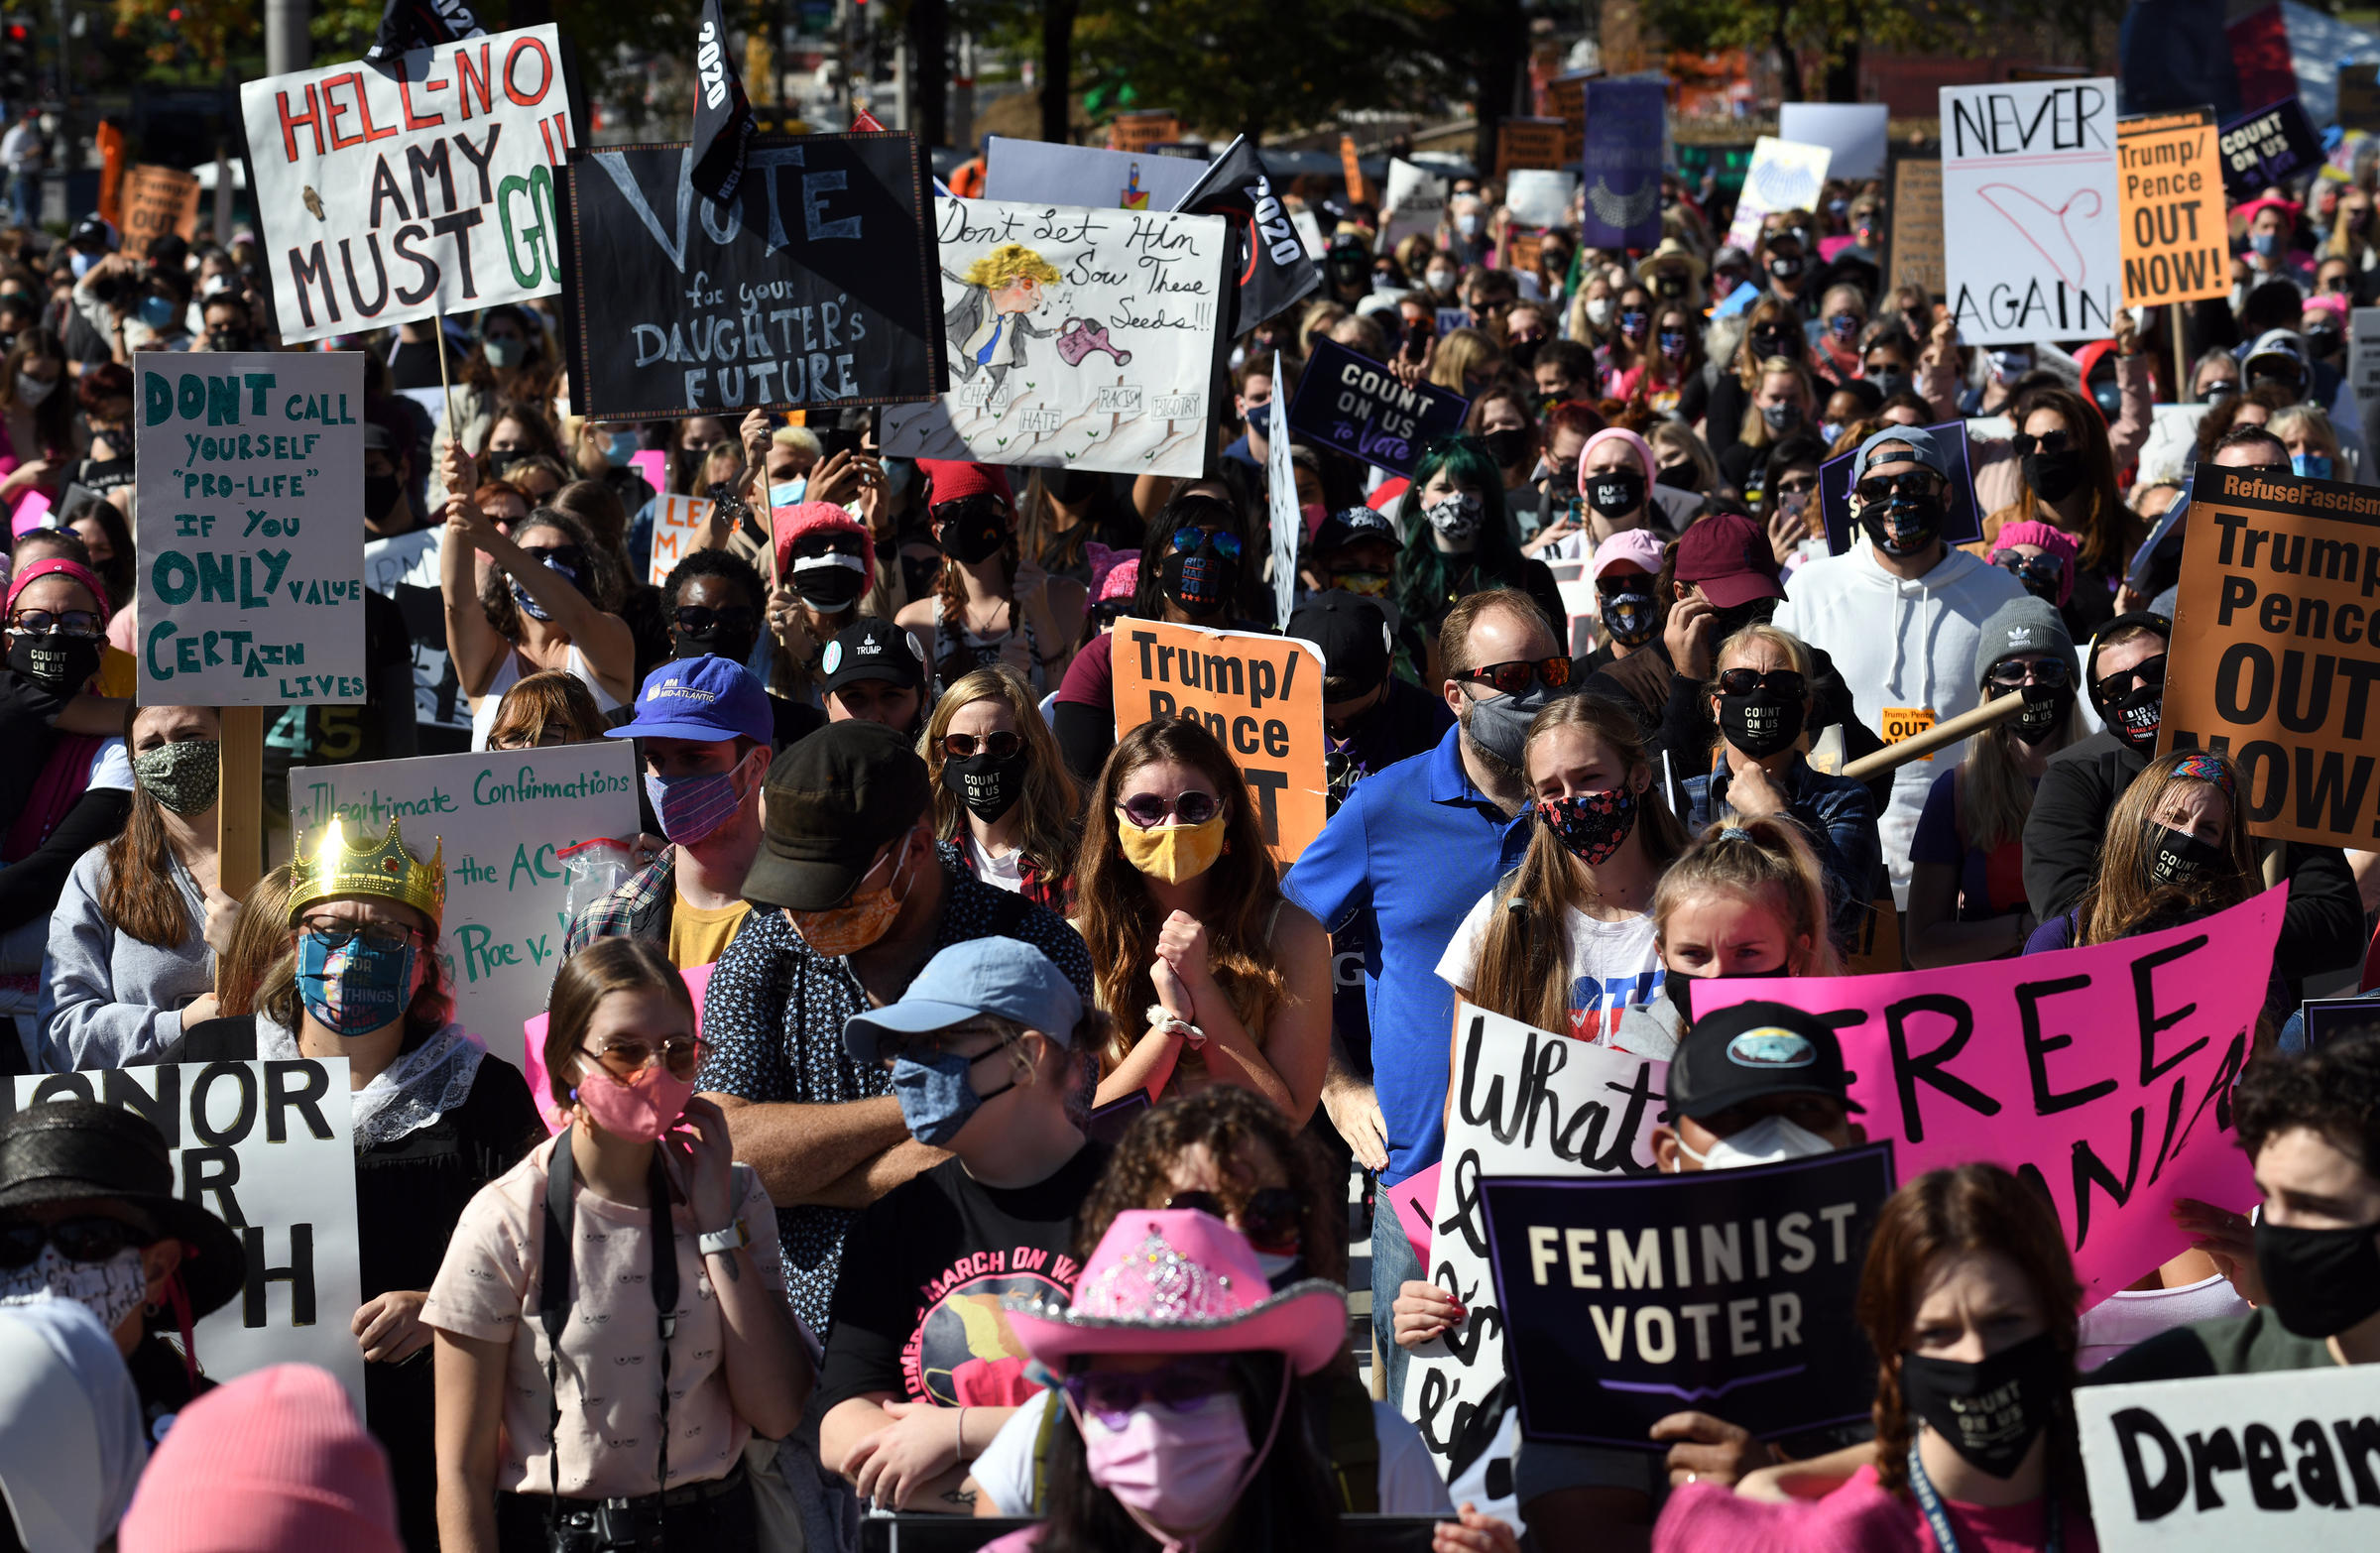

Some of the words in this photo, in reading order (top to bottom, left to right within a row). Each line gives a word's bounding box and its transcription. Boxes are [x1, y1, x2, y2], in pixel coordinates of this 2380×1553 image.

[699, 21, 727, 111] 2020
[276, 36, 553, 163] HELL-NO
[1953, 84, 2108, 158] NEVER
[2117, 131, 2205, 170] Trump/
[2219, 111, 2283, 157] COUNT
[2230, 147, 2259, 173] ON
[2260, 134, 2290, 159] US
[370, 123, 502, 228] AMY
[2126, 171, 2202, 201] Pence
[592, 145, 863, 275] VOTE
[937, 198, 1024, 246] Don't
[1033, 208, 1109, 245] Let
[1125, 214, 1200, 258] Him
[1244, 175, 1301, 266] 2020
[2134, 199, 2202, 249] OUT
[289, 206, 484, 328] MUST
[1066, 248, 1128, 287] Sow
[1137, 255, 1211, 296] These
[2124, 247, 2223, 299] NOW!
[684, 271, 725, 309] for
[739, 281, 794, 316] your
[1953, 276, 2111, 333] AGAIN
[631, 293, 866, 369] DAUGHTER'S
[144, 371, 277, 428] DONT
[285, 393, 357, 425] CALL
[684, 353, 859, 410] FUTURE
[1100, 388, 1141, 410] RACISM
[1341, 362, 1435, 418] COUNT
[1021, 411, 1060, 430] HATE
[1154, 398, 1200, 418] BIGOTRY
[1337, 390, 1373, 421] ON
[1381, 409, 1416, 440] US
[183, 432, 321, 468] YOURSELF
[173, 468, 319, 500] "PRO-LIFE"
[174, 514, 216, 538] IF
[242, 509, 300, 538] YOU
[151, 547, 293, 610] ONLY
[287, 578, 362, 607] VALUE
[31, 649, 67, 662] COUNT
[33, 661, 46, 671] ON
[50, 662, 64, 673] US
[146, 620, 305, 681] CERTAIN
[857, 646, 882, 656] TRUMP
[1131, 630, 1299, 709] Trump/
[279, 673, 365, 699] LIVES
[659, 689, 715, 703] MID-ATLANTIC
[2214, 642, 2380, 741] OUT
[1745, 706, 1782, 718] COUNT
[1746, 718, 1760, 729] ON
[1765, 719, 1778, 729] US
[1888, 721, 1930, 737] OUT
[2022, 712, 2036, 722] ON
[2040, 710, 2053, 721] US
[474, 765, 630, 806] Confirmations
[964, 773, 1001, 786] COUNT
[968, 785, 981, 797] ON
[986, 784, 1000, 796] US
[453, 854, 497, 886] the
[2156, 862, 2173, 878] ON
[2160, 850, 2201, 872] COUNT
[344, 956, 373, 973] FOR
[452, 923, 523, 974] Roe
[343, 988, 396, 1004] THINGS
[1527, 1202, 1857, 1290] FEMINIST
[920, 1250, 1006, 1303] MARCH
[1012, 1246, 1048, 1271] ON
[1589, 1291, 1804, 1366] VOTER
[1958, 1414, 1988, 1432] ON
